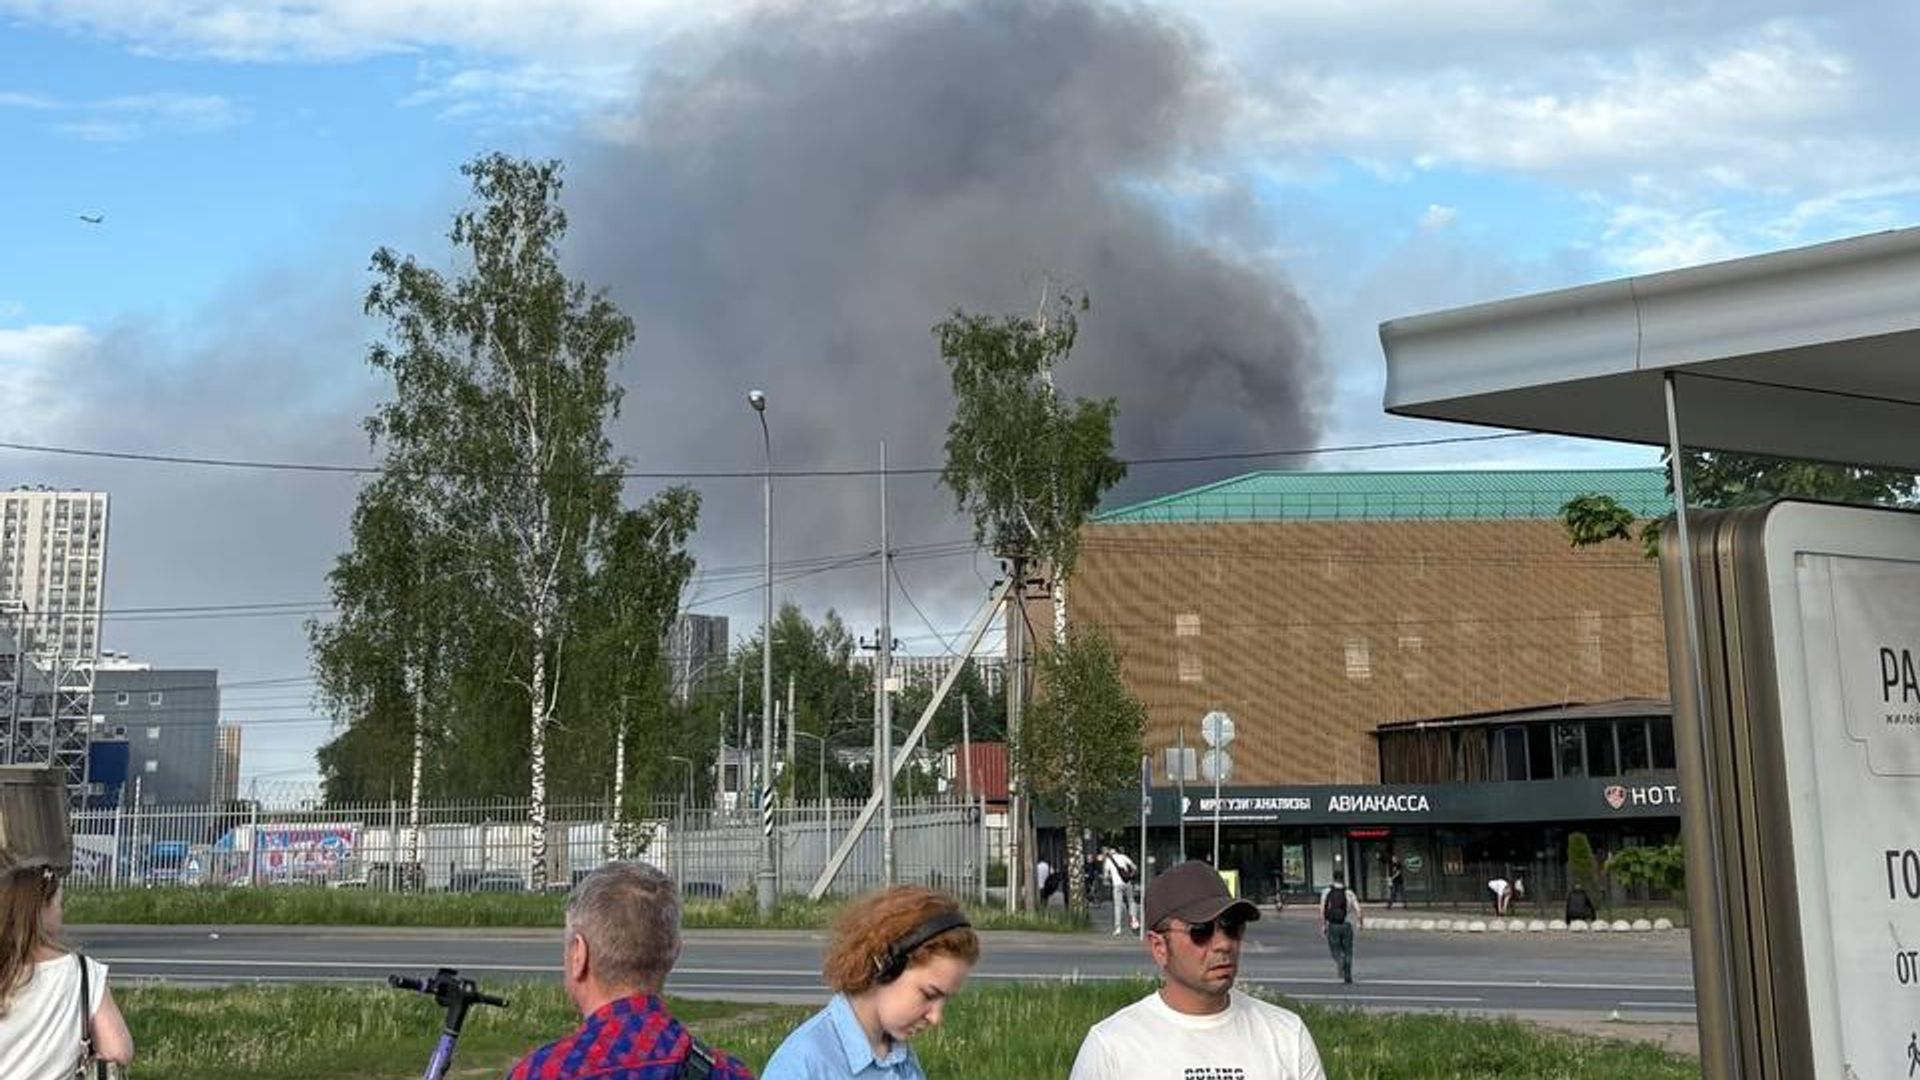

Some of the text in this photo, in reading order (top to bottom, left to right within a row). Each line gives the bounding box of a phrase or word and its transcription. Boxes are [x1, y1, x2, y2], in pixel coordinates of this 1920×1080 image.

[1880, 647, 1920, 703] РА
[1254, 797, 1311, 810] АНАЛИЗЫ
[1328, 795, 1430, 812] АВИАКАССА
[1631, 786, 1681, 805] НОТ
